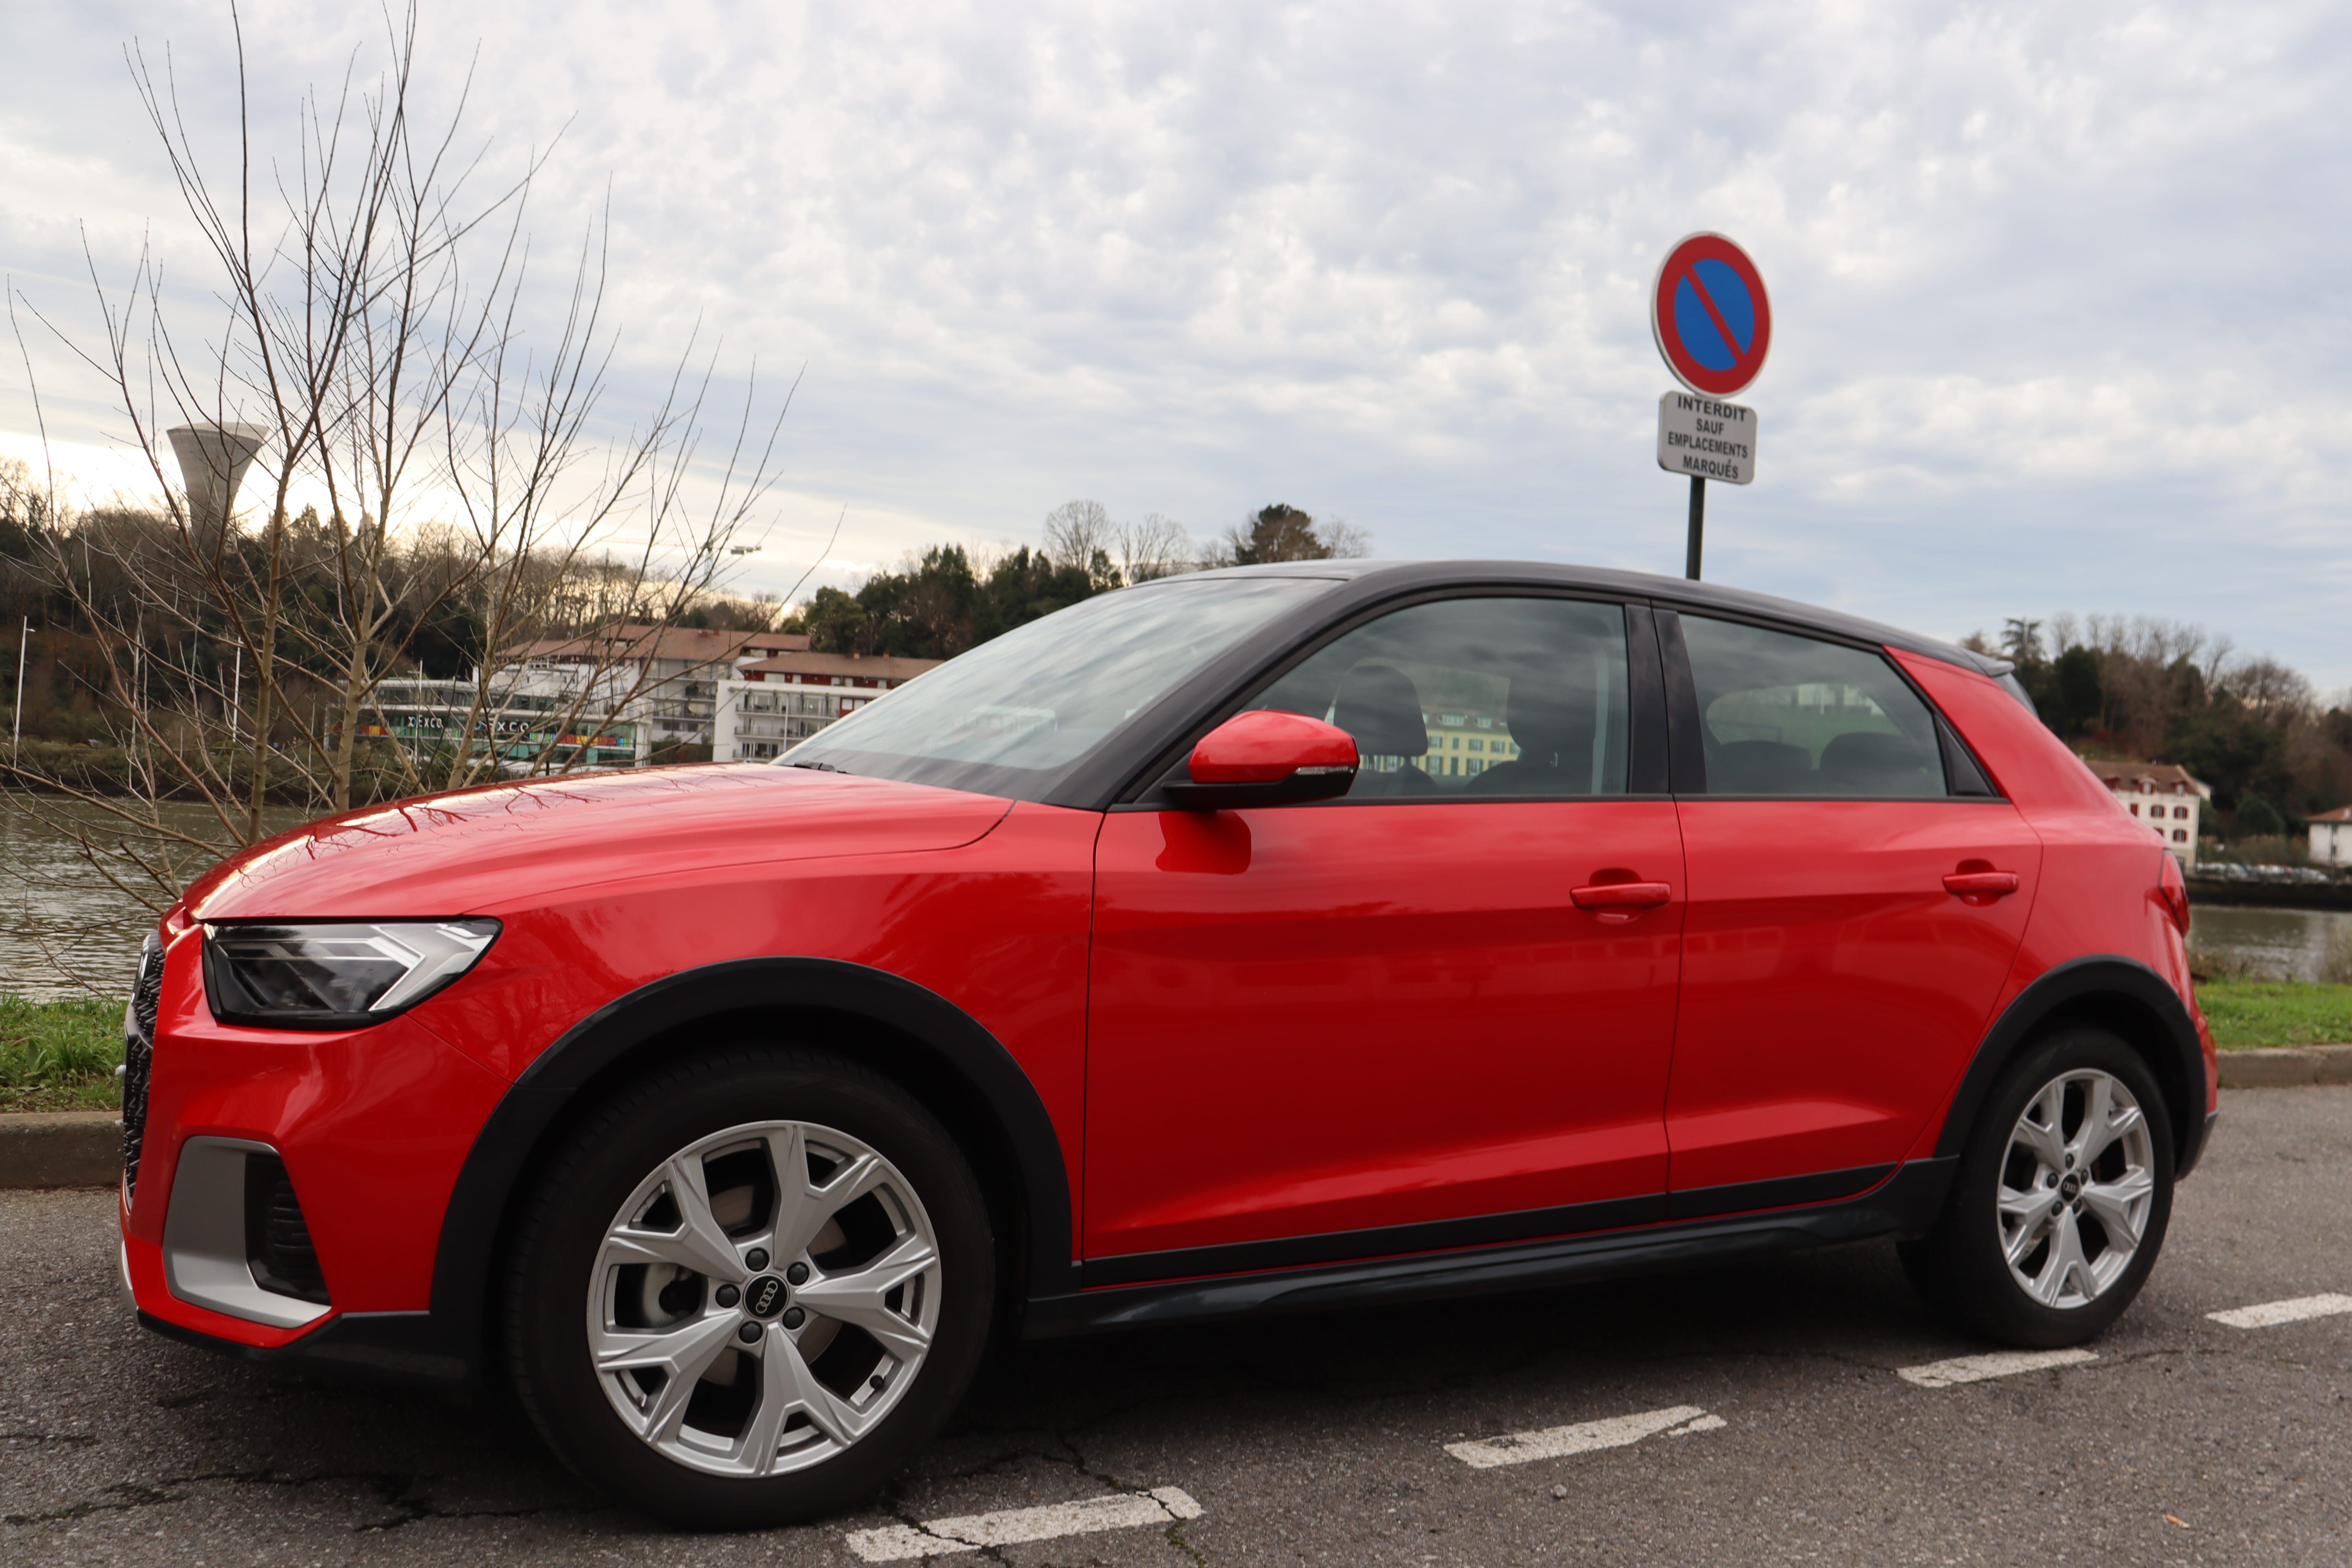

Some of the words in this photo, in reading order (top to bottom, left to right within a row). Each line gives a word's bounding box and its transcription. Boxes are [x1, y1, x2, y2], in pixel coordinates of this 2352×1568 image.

[1677, 395, 1746, 421] INTERDIT
[1696, 418, 1724, 435] SAUF
[1668, 432, 1748, 459] EMPLACEMENTS
[1683, 455, 1739, 479] MARQUÉS
